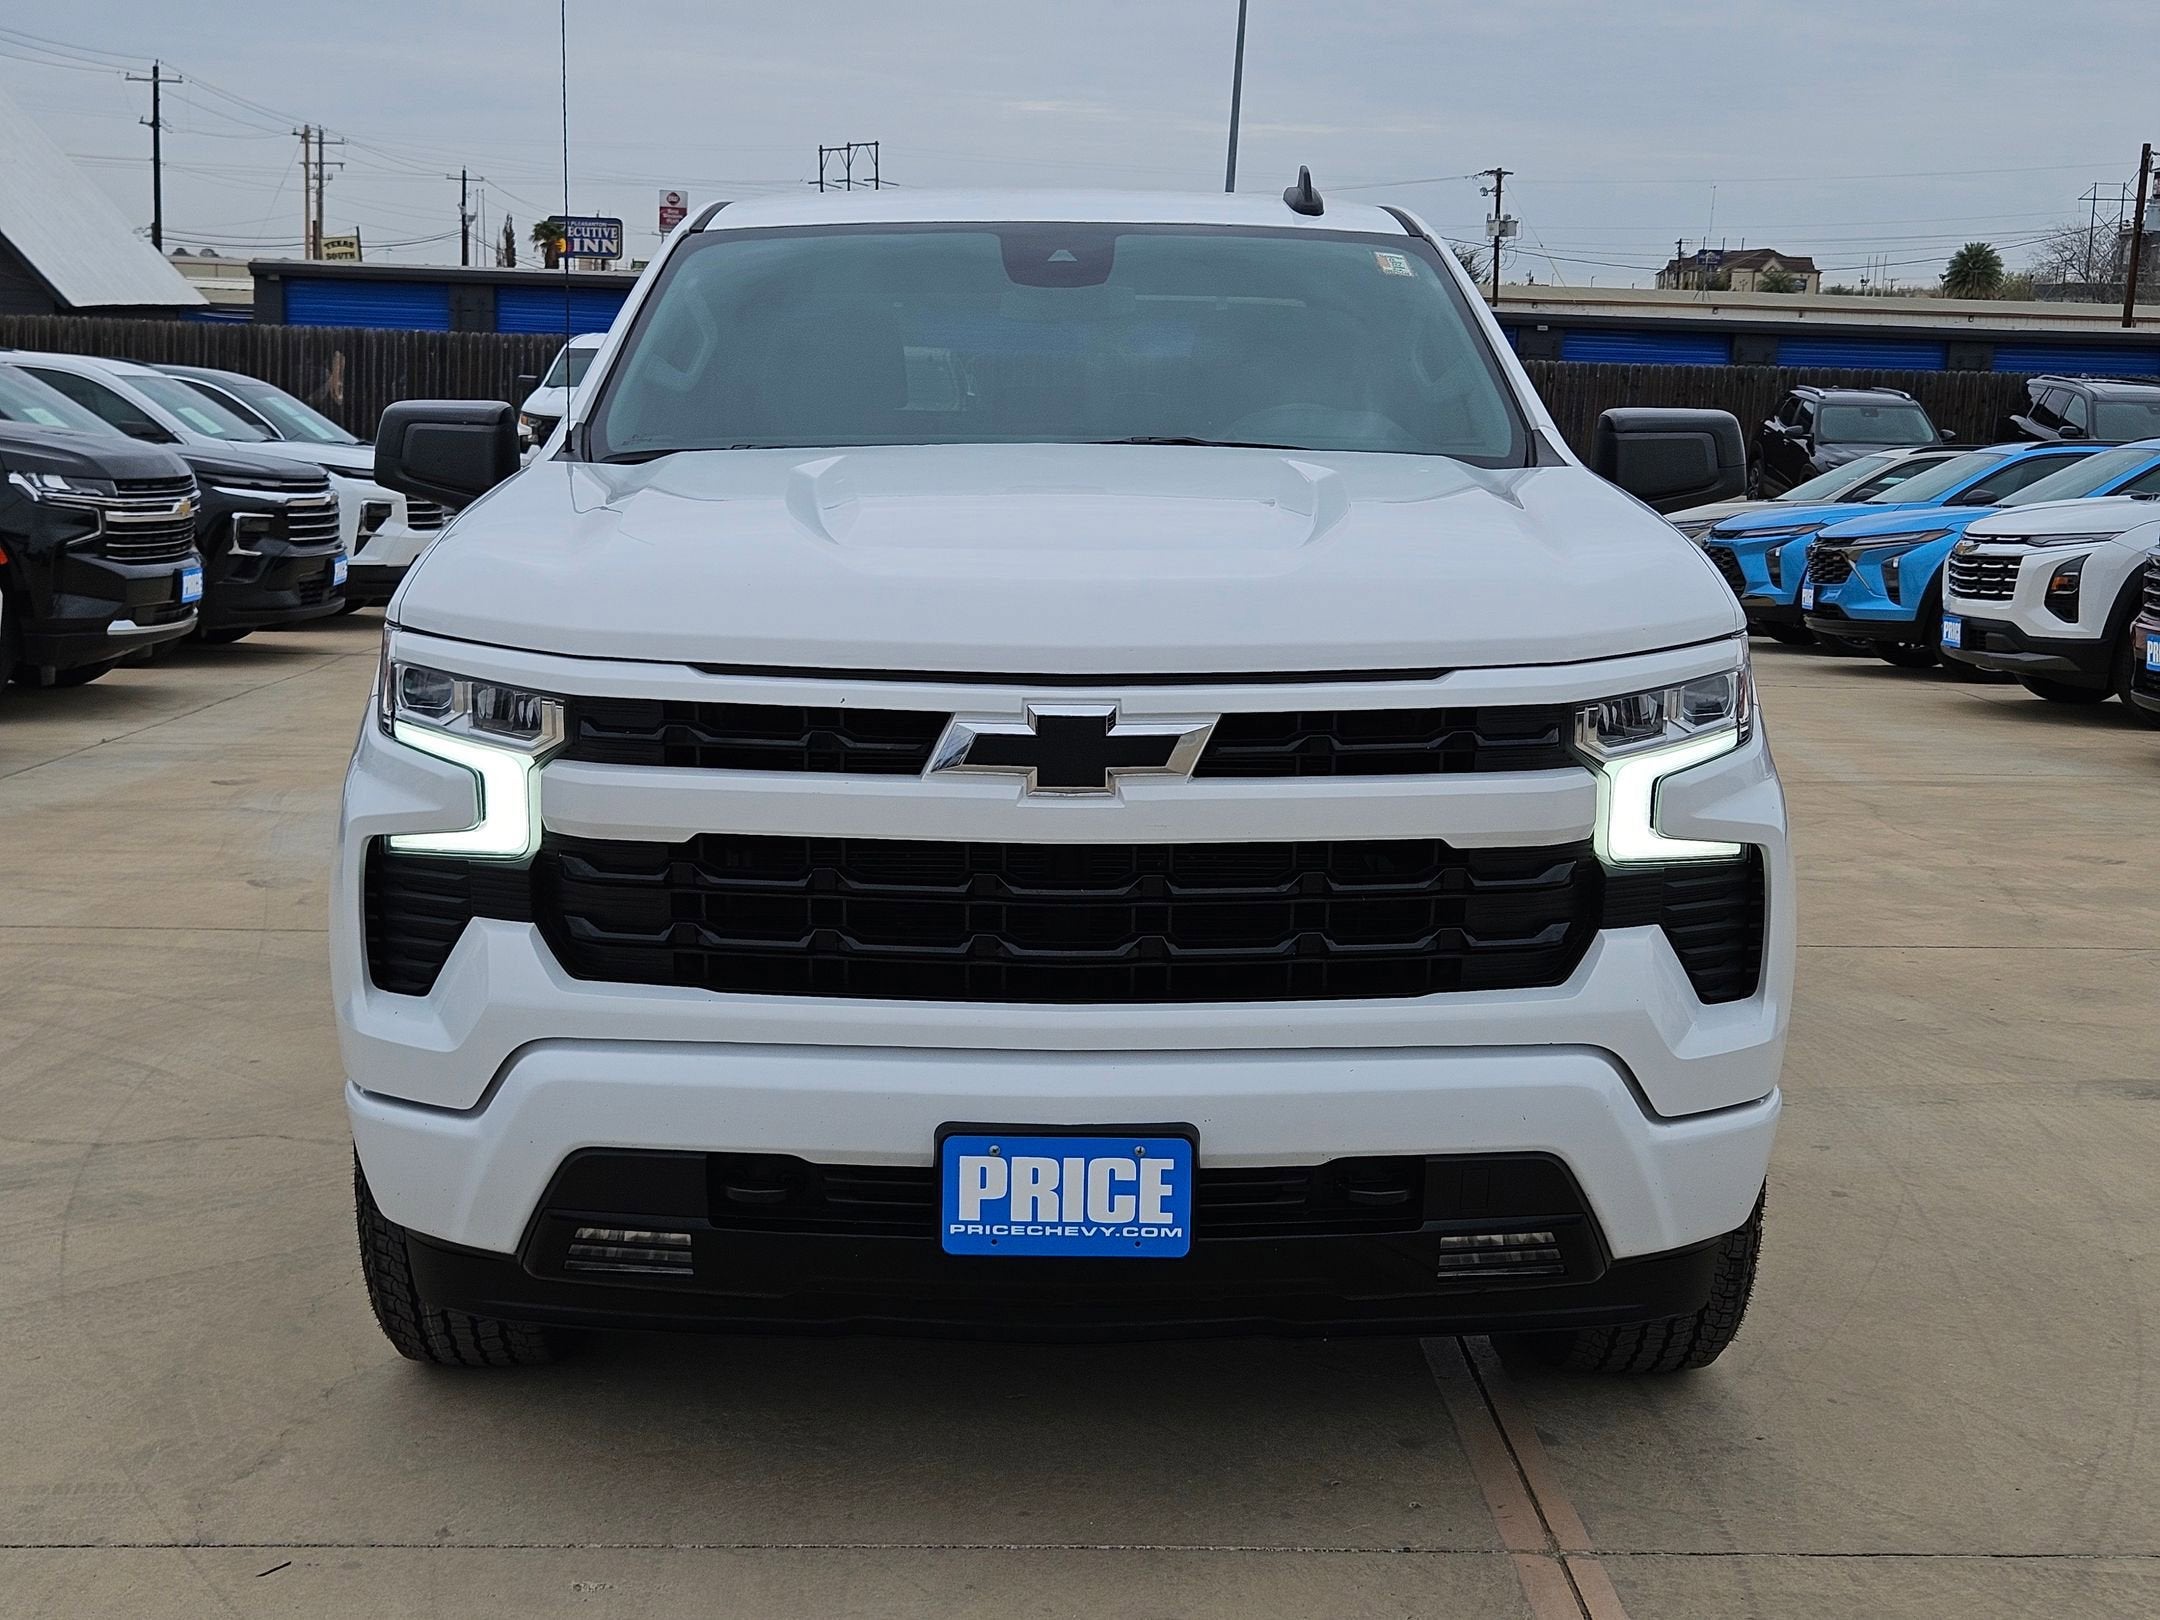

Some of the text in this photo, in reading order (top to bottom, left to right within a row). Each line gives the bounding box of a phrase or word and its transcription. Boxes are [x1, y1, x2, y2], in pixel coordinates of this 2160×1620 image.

[567, 226, 618, 239] ECUTIVE
[573, 238, 618, 253] INN
[958, 1156, 1175, 1224] PRICE
[950, 1224, 1182, 1238] PRICECHEVY.COM
